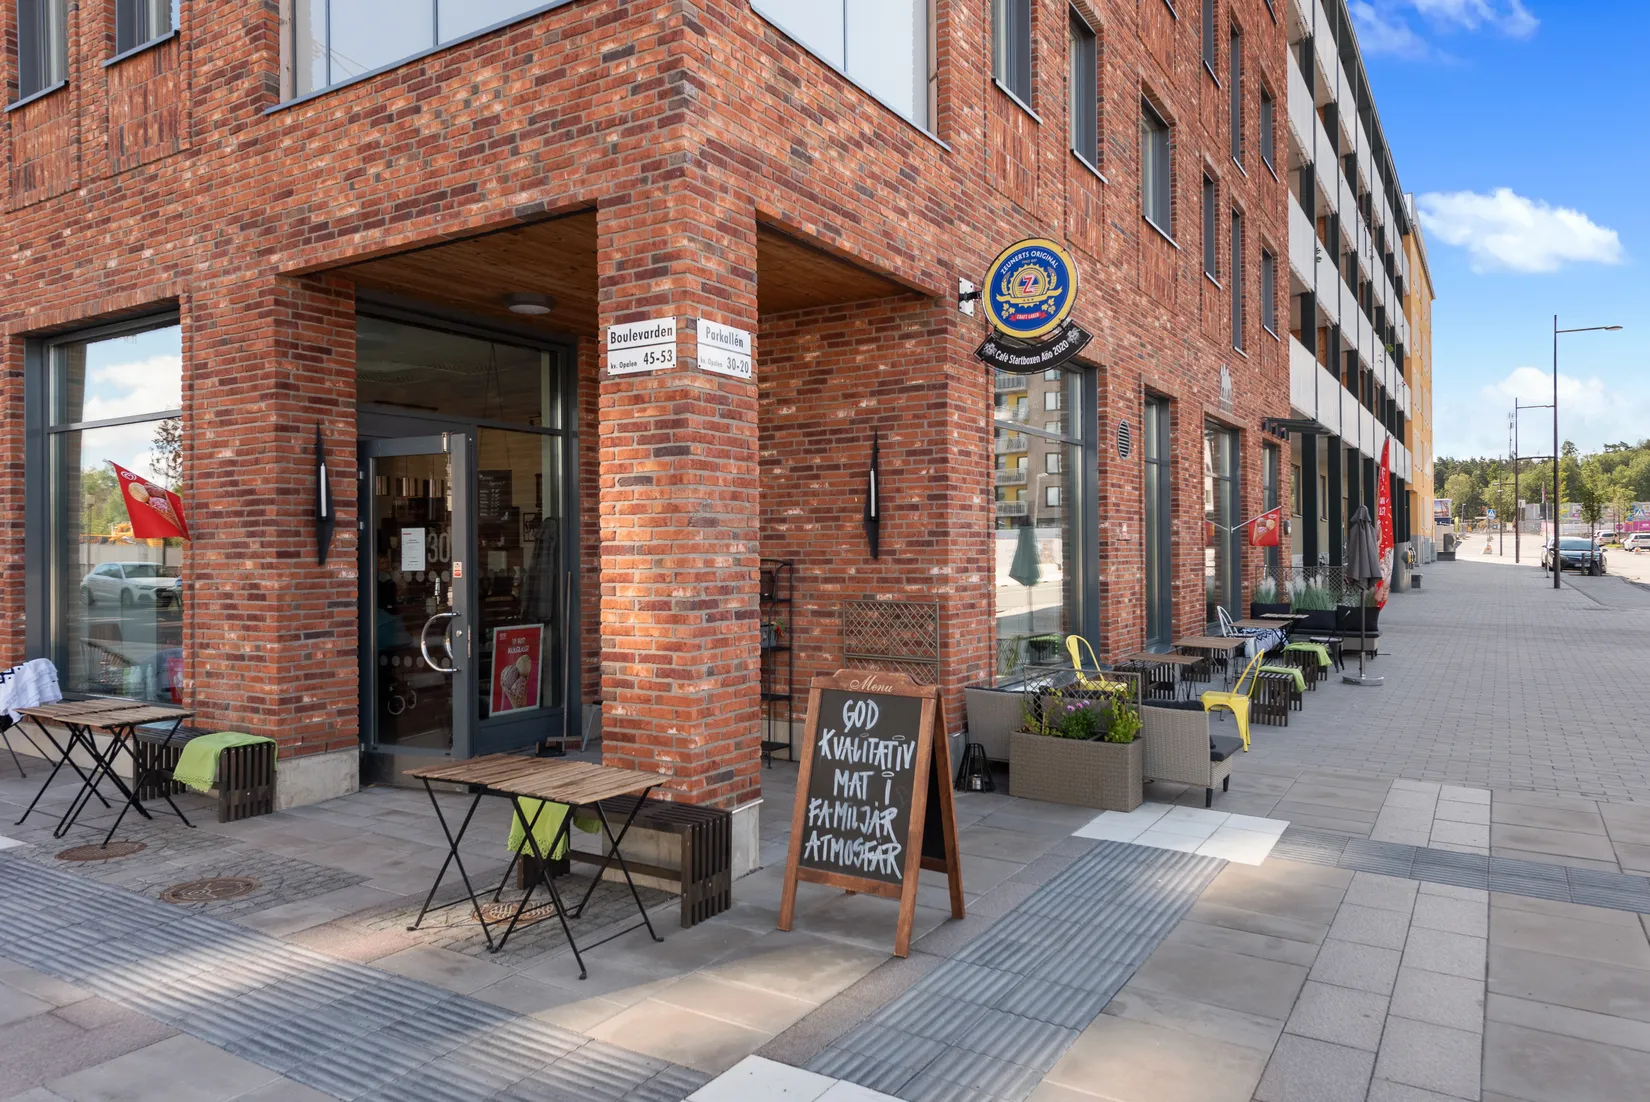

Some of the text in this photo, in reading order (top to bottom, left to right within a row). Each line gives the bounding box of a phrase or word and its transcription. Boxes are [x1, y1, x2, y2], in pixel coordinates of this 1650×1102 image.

[1000, 250, 1059, 275] ZEUNERTS ORIGINAL
[1023, 275, 1034, 294] Z
[610, 324, 673, 344] Boulevarden
[705, 326, 744, 348] Parkallén
[610, 349, 673, 370] kv. Opalen 45-53
[995, 350, 1009, 363] Café
[1009, 354, 1041, 365] Startboxen
[1053, 340, 1069, 355] 2020
[708, 358, 723, 368] Opalen
[726, 356, 749, 374] 30-20
[427, 532, 451, 563] 30
[850, 675, 894, 693] Menu
[842, 699, 880, 733] GOD
[818, 728, 916, 772] KVALITATIV
[833, 768, 875, 801] MAT
